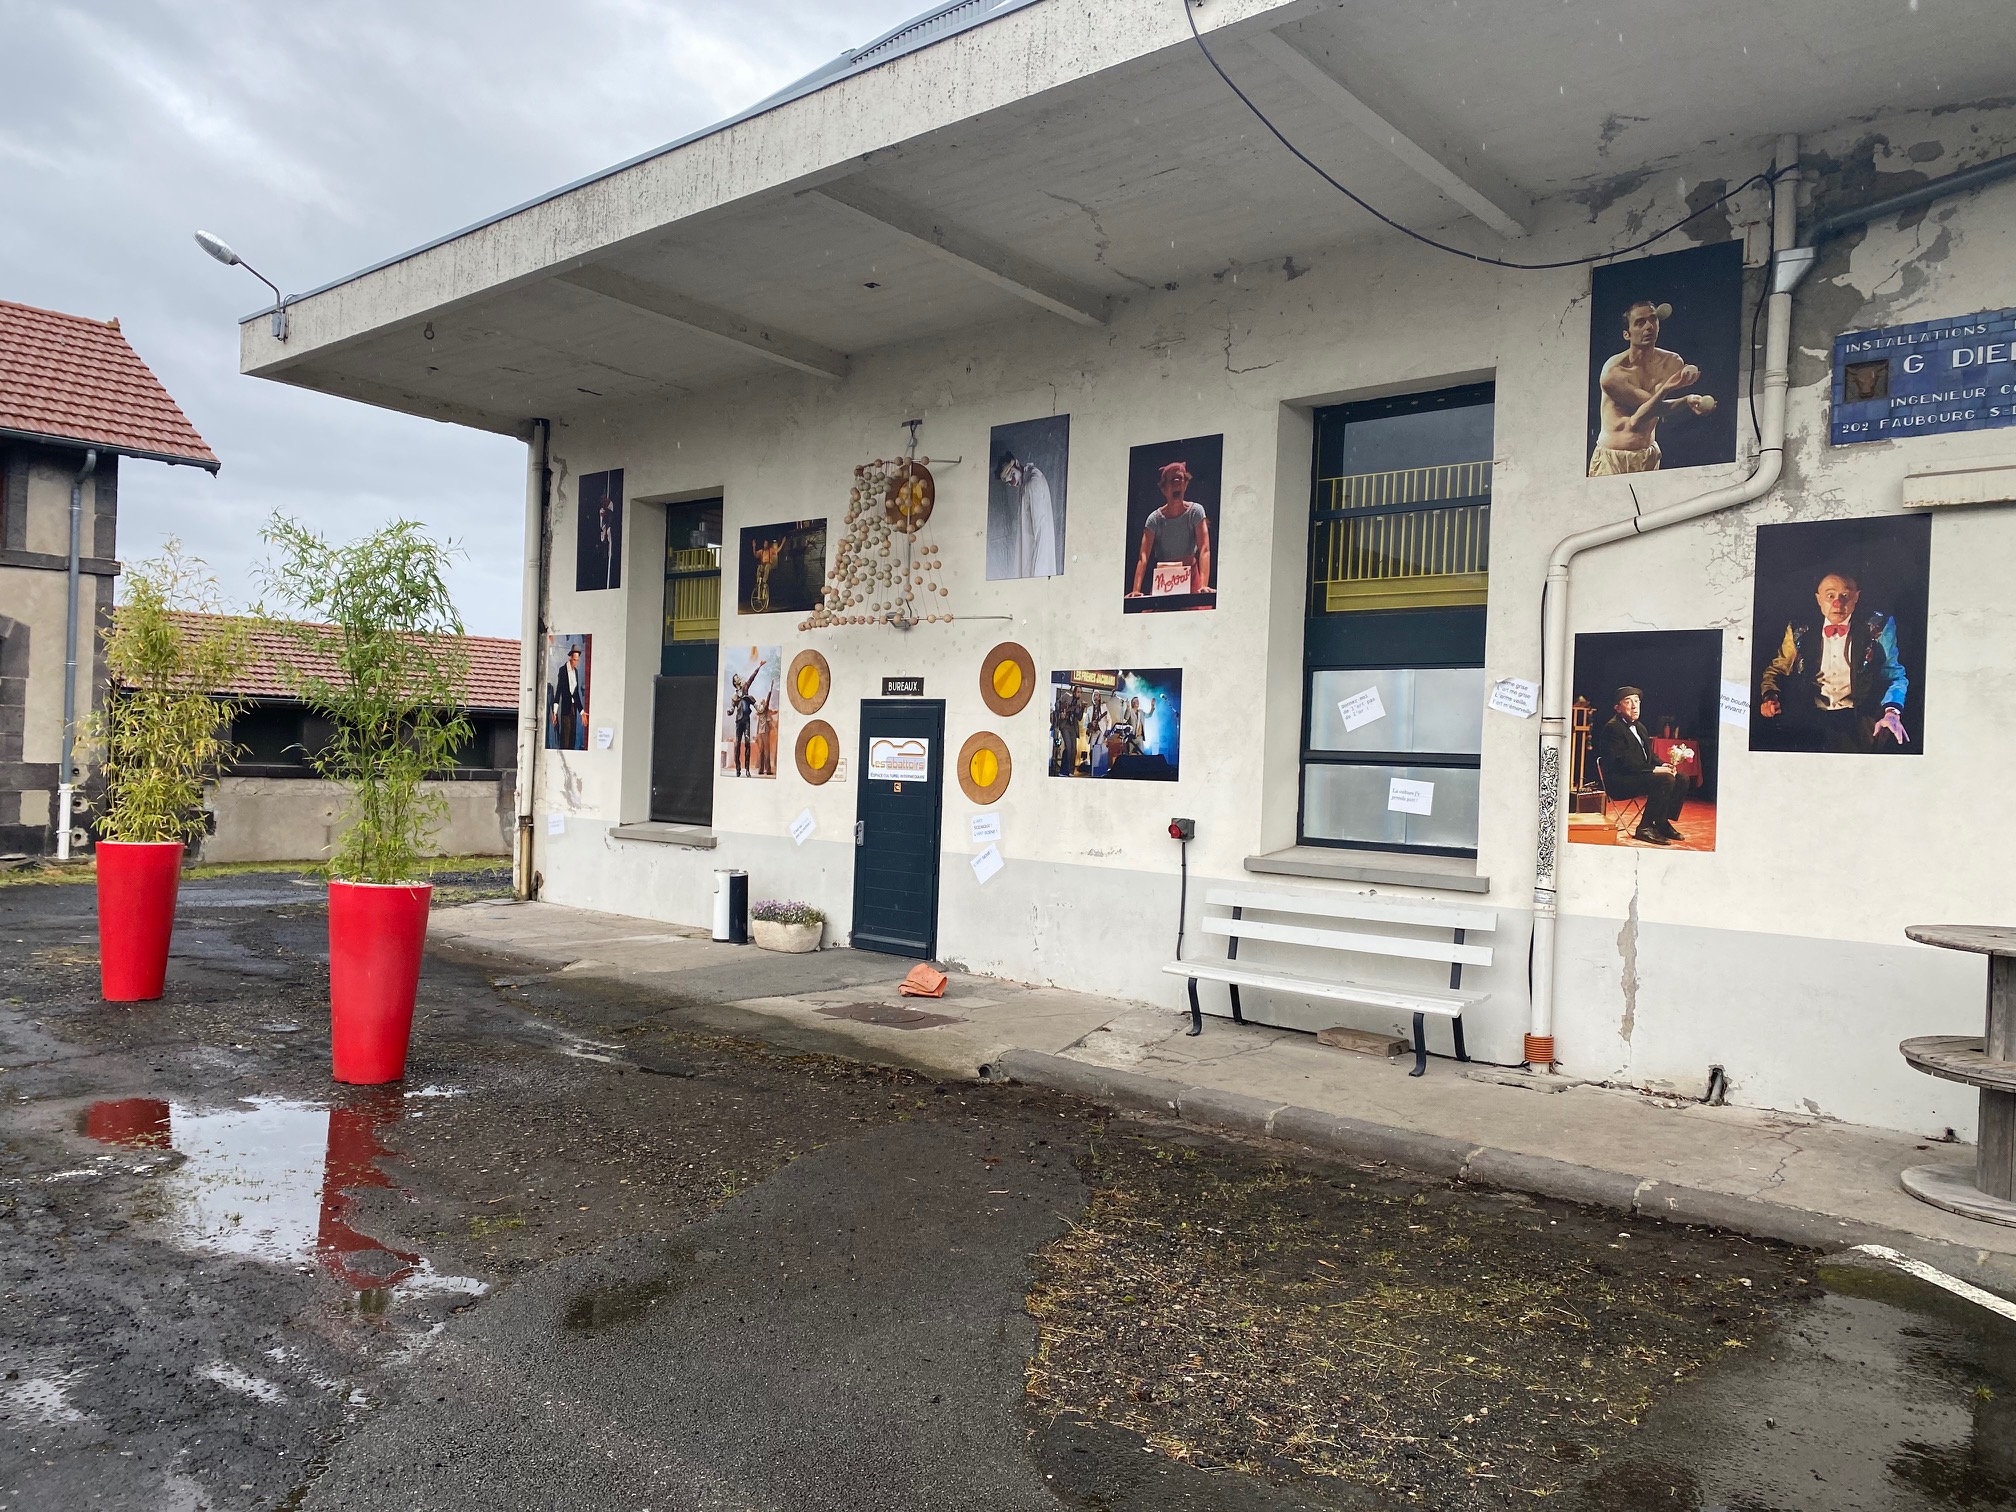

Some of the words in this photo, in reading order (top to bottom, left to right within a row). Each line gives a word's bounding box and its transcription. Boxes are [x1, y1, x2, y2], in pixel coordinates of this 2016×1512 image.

[1846, 324, 1987, 353] INSTALLATIONS
[1903, 355, 1924, 374] G
[1891, 388, 1986, 408] INGENIEUR
[2000, 384, 2016, 394] C
[1842, 422, 1869, 433] 202
[1879, 409, 1976, 429] FAUBOURG
[1990, 405, 2016, 417] S-
[886, 758, 925, 769] abattoirs
